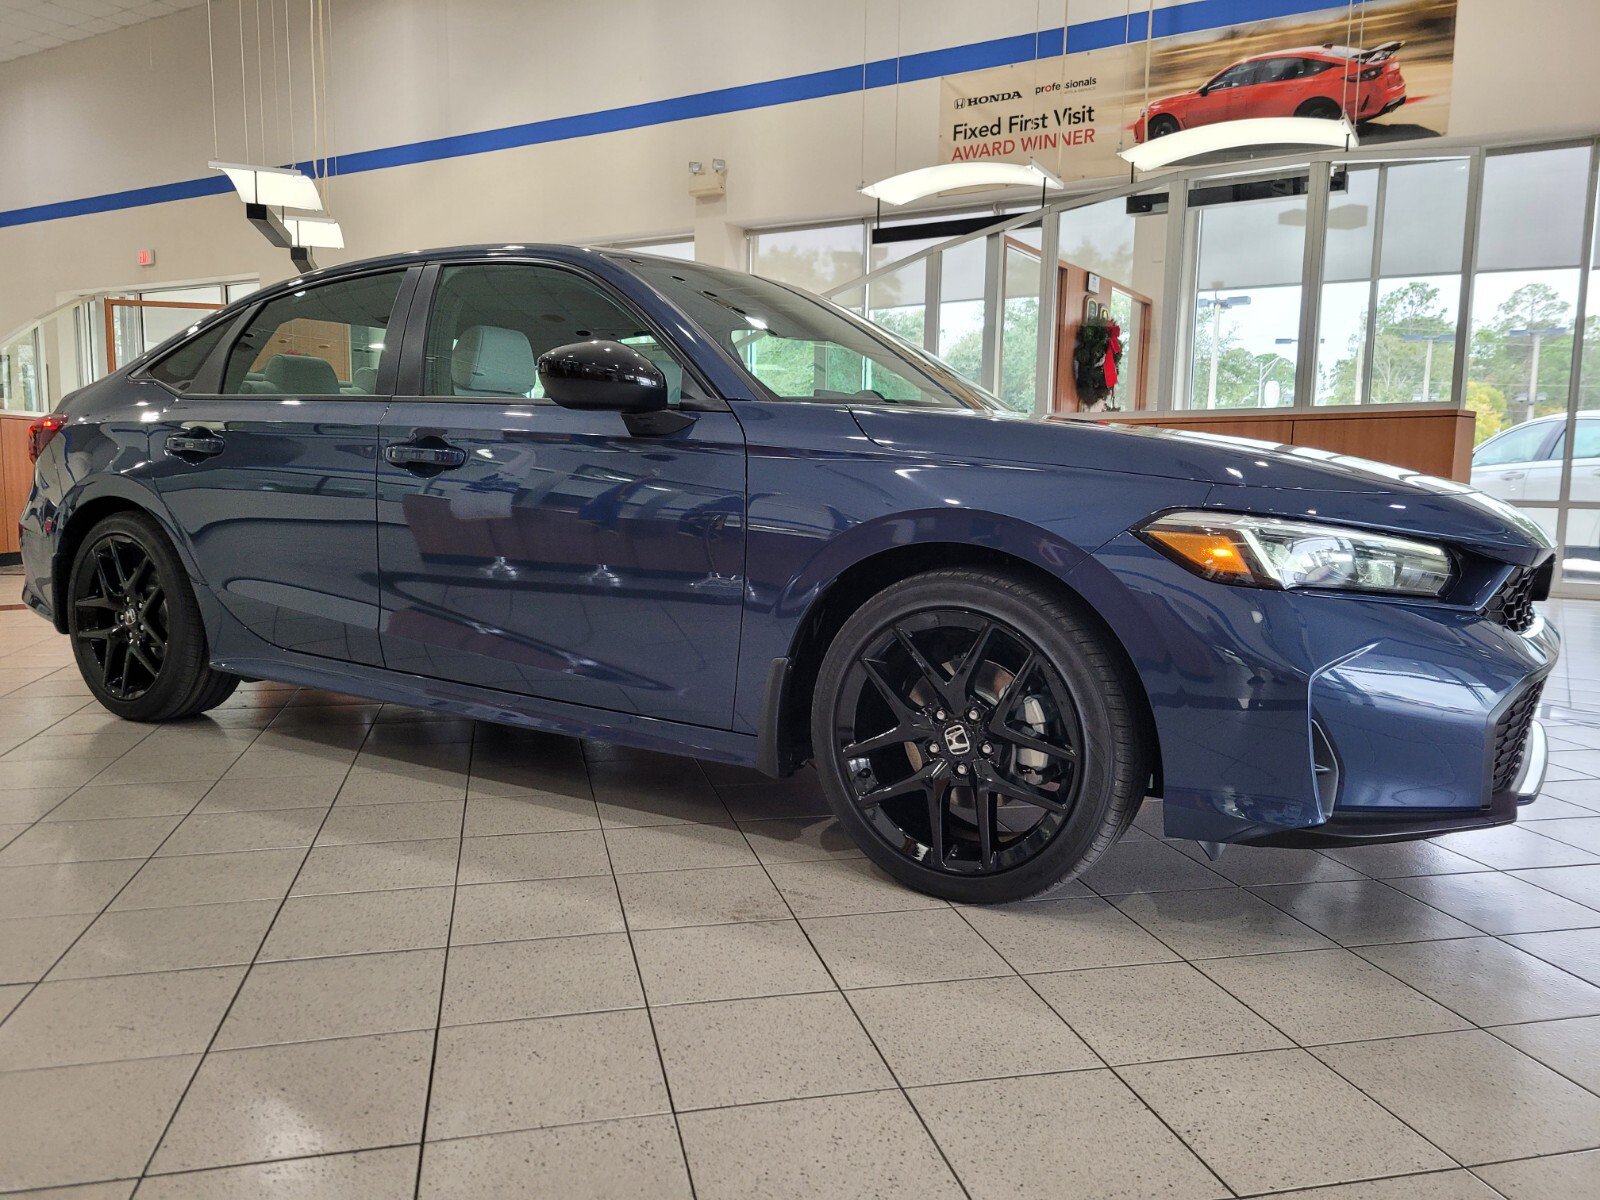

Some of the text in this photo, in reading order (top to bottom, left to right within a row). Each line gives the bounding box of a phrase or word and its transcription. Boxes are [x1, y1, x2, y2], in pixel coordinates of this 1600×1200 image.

[967, 90, 1023, 106] HONDA
[1035, 77, 1097, 95] profesionals
[953, 105, 1095, 141] Fixed First Visit
[951, 128, 1096, 162] AWARD WINNER
